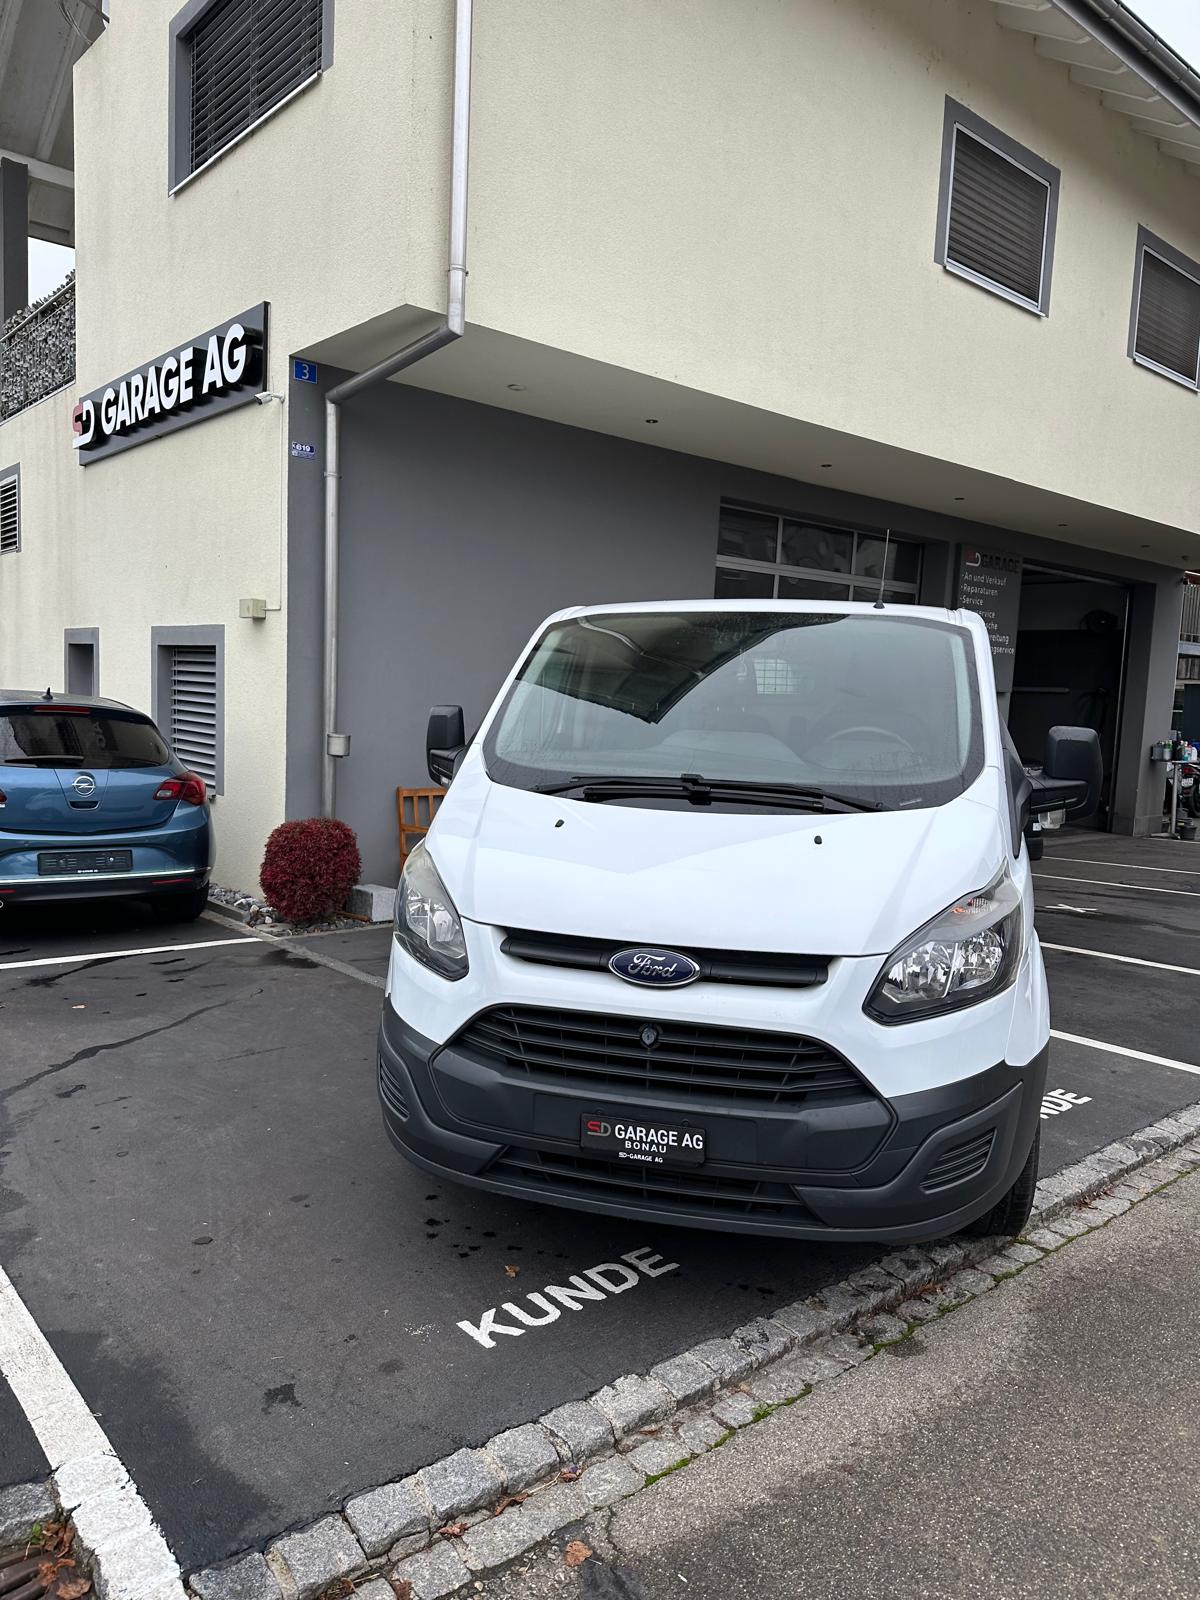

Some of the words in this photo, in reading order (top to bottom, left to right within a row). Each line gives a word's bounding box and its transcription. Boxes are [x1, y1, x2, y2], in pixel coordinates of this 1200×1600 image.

[101, 346, 194, 435] GARAGE
[202, 323, 247, 394] AG
[302, 364, 310, 379] 3
[974, 575, 984, 583] und
[986, 575, 1007, 586] Verkauf
[964, 583, 998, 596] Reparaturen
[962, 595, 984, 606] Service
[628, 953, 677, 977] Ford
[587, 1121, 611, 1136] SD
[614, 1124, 678, 1146] GARAGE
[681, 1133, 703, 1149] AG
[625, 1141, 667, 1153] BONAU
[456, 1247, 680, 1348] KUNDE
